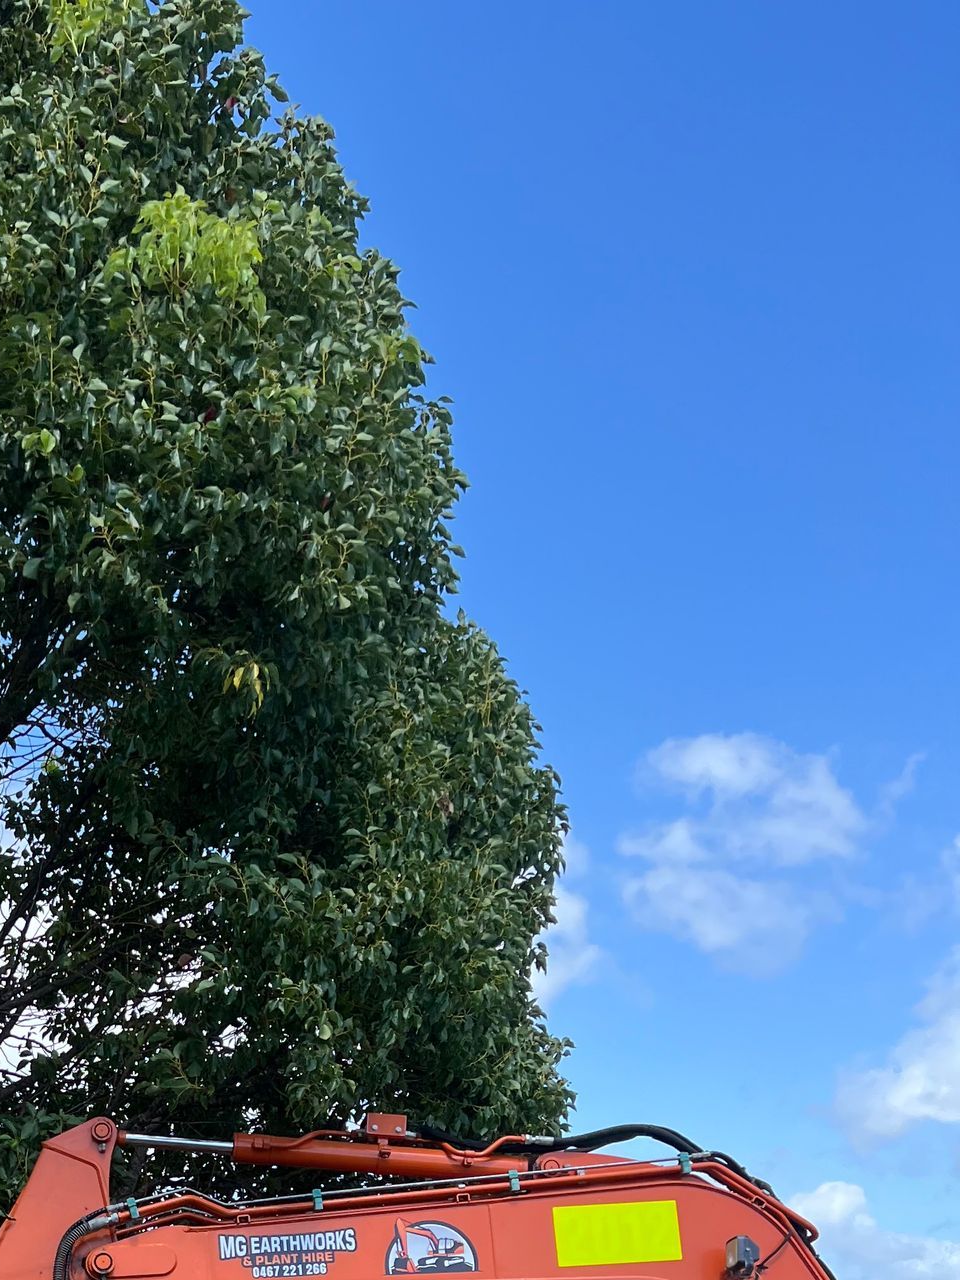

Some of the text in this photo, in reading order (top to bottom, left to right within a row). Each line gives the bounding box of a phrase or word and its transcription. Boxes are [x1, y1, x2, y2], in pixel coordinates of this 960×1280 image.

[219, 1229, 356, 1259] MG EARTHWORKS
[243, 1252, 334, 1267] & PLANT HIRE
[252, 1263, 327, 1278] 0467 221 266
